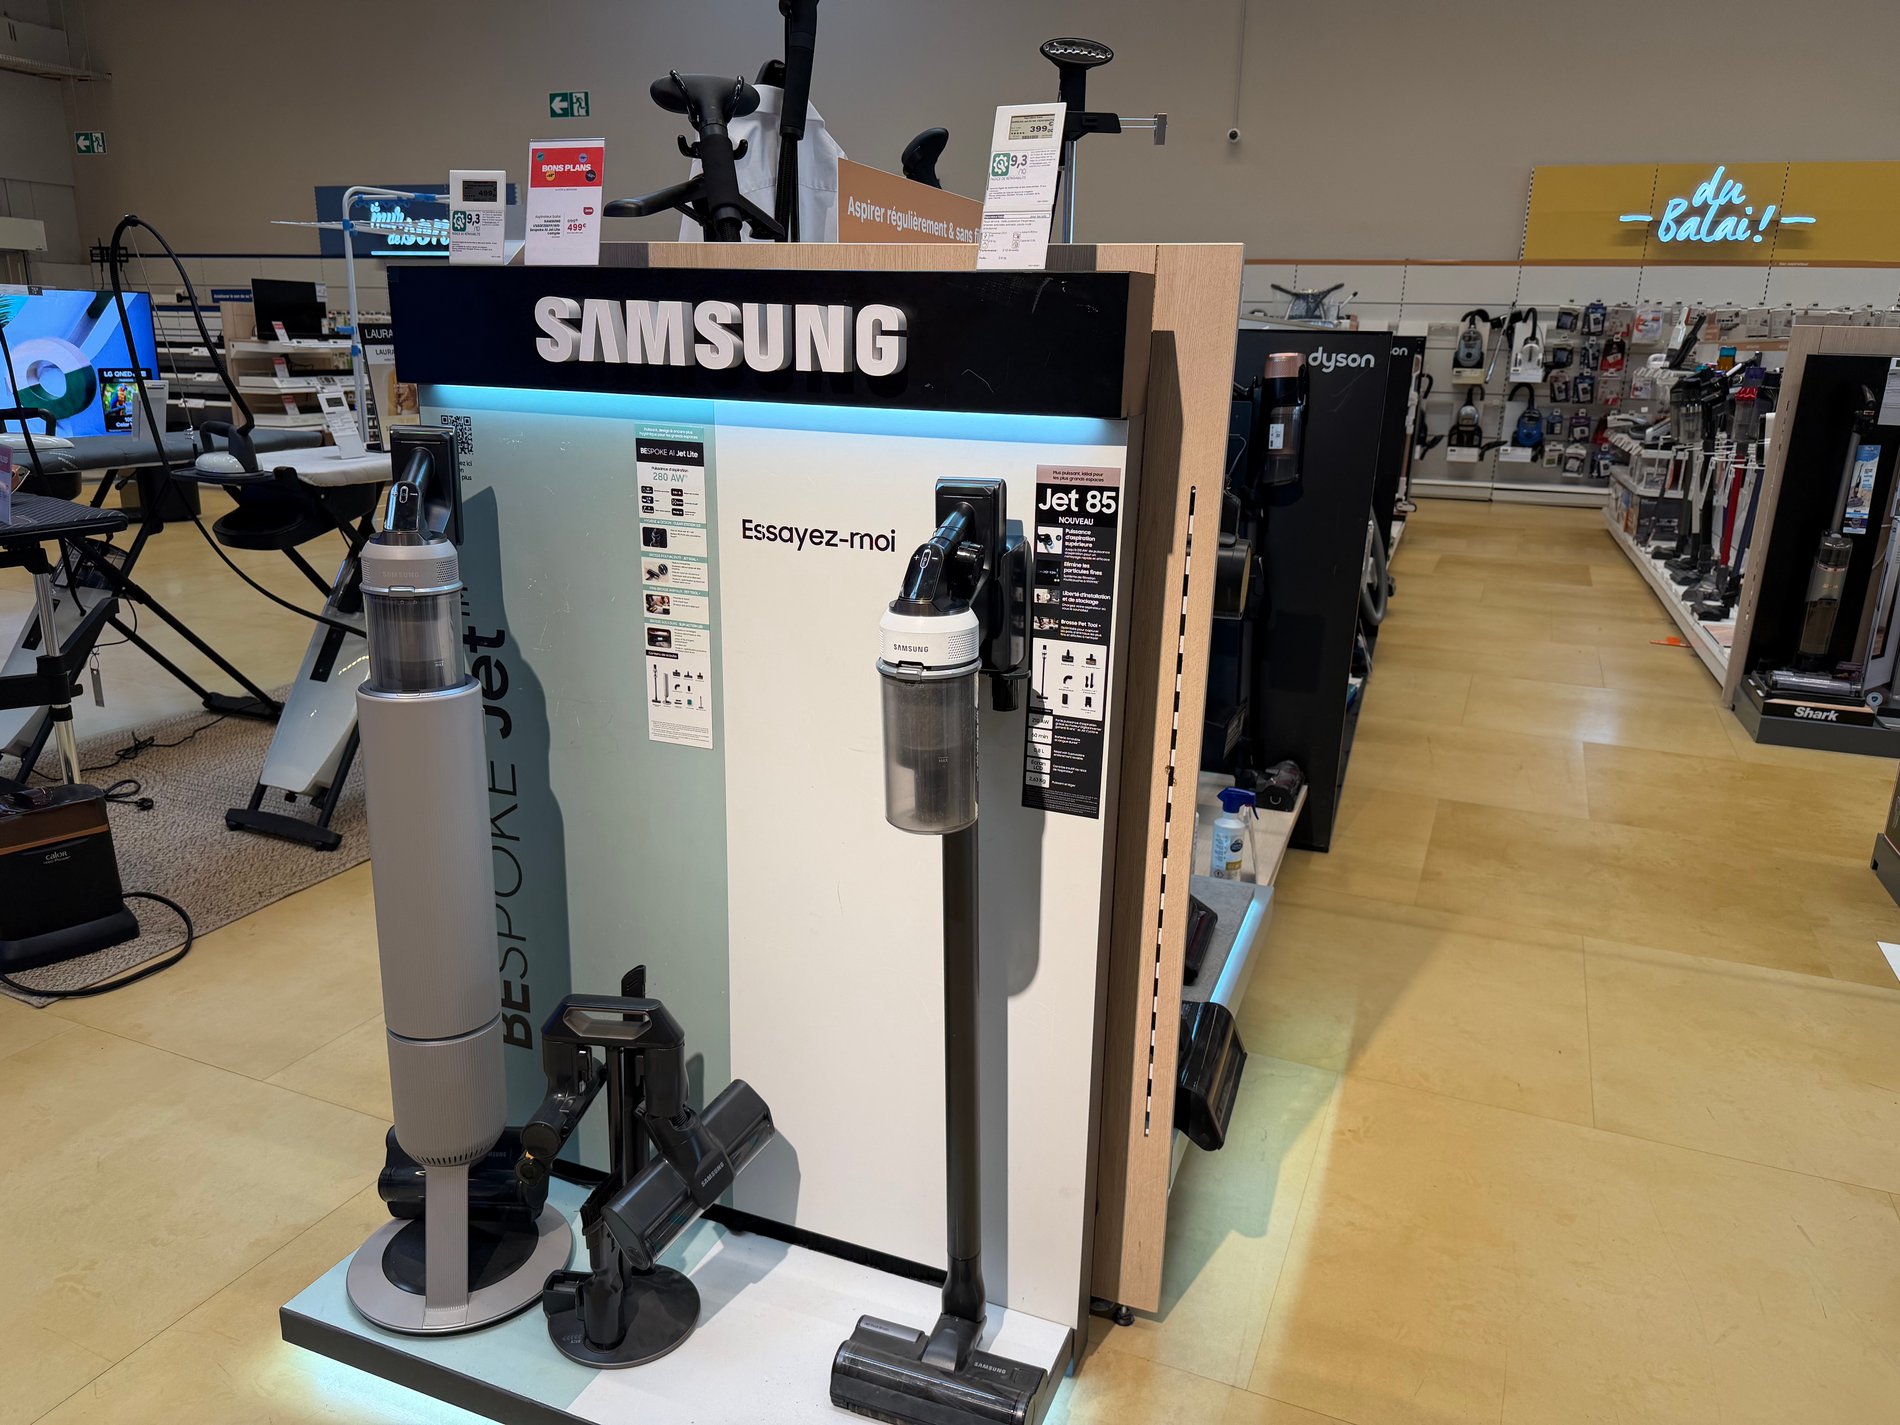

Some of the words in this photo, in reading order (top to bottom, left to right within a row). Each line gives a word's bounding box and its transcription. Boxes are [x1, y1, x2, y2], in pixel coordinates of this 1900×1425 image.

[565, 164, 591, 172] PLANS
[1011, 154, 1028, 168] 9,3
[1692, 166, 1746, 208] du
[467, 213, 480, 226] 9,3
[847, 196, 885, 222] Aspirer
[887, 206, 947, 238] régulièrement
[948, 222, 954, 240] &
[956, 226, 973, 243] sans
[365, 329, 393, 339] LAURA
[534, 296, 908, 376] SAMSUNG
[1308, 346, 1375, 373] dyson
[640, 448, 667, 456] BESPOKE
[653, 472, 668, 481] 280
[1038, 488, 1079, 512] Jet
[1086, 490, 1116, 514] 85
[1059, 516, 1093, 525] NOUVEAU
[742, 518, 895, 552] Essayez-moi
[893, 644, 929, 653] SAMSUNG
[1794, 706, 1840, 721] Shark
[46, 851, 67, 861] calor
[488, 760, 533, 1050] BESPOKE
[701, 1162, 724, 1187] SAMSUNG
[974, 1362, 1007, 1374] SAMSUNG
